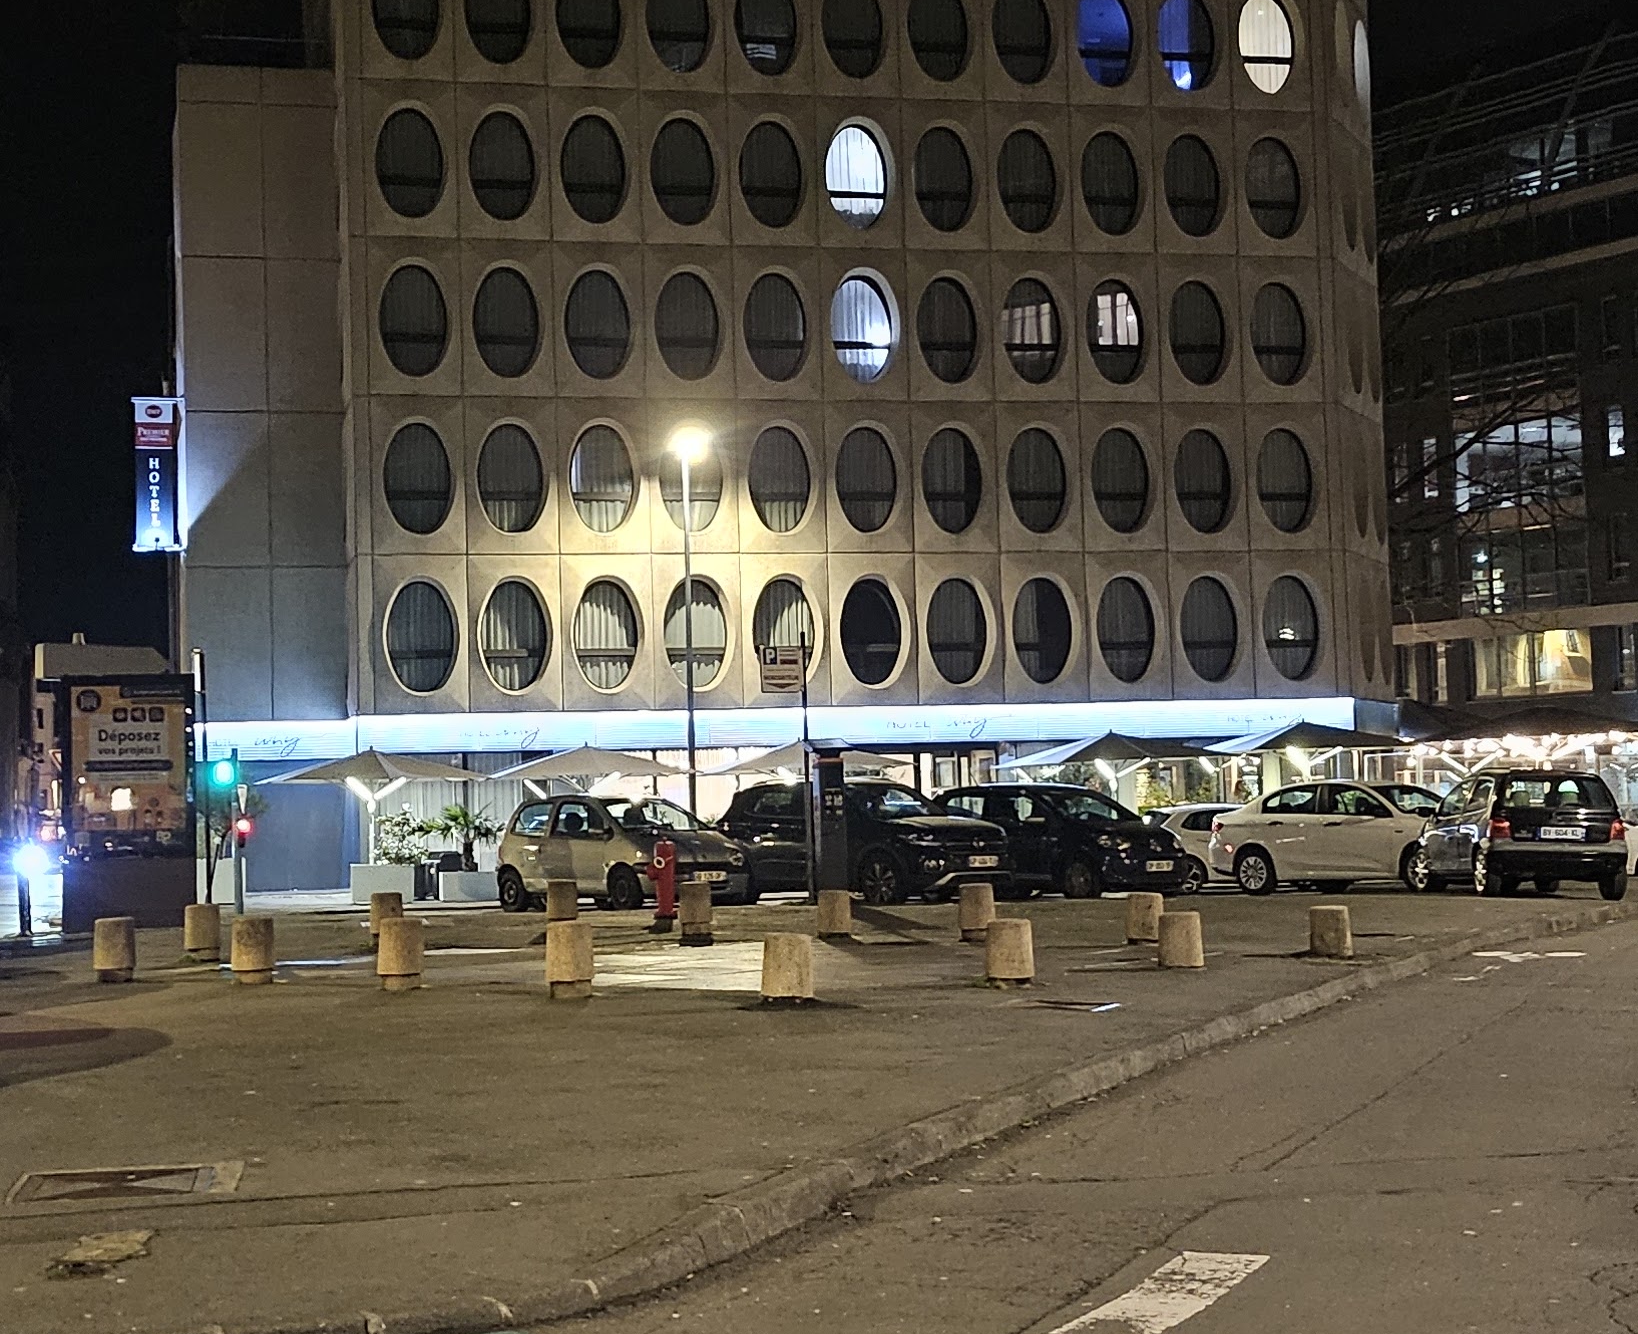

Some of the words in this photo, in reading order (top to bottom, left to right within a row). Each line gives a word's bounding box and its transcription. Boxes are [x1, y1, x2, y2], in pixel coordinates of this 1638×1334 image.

[148, 457, 161, 528] HOTEL
[765, 648, 776, 664] P
[98, 729, 161, 746] Déposez
